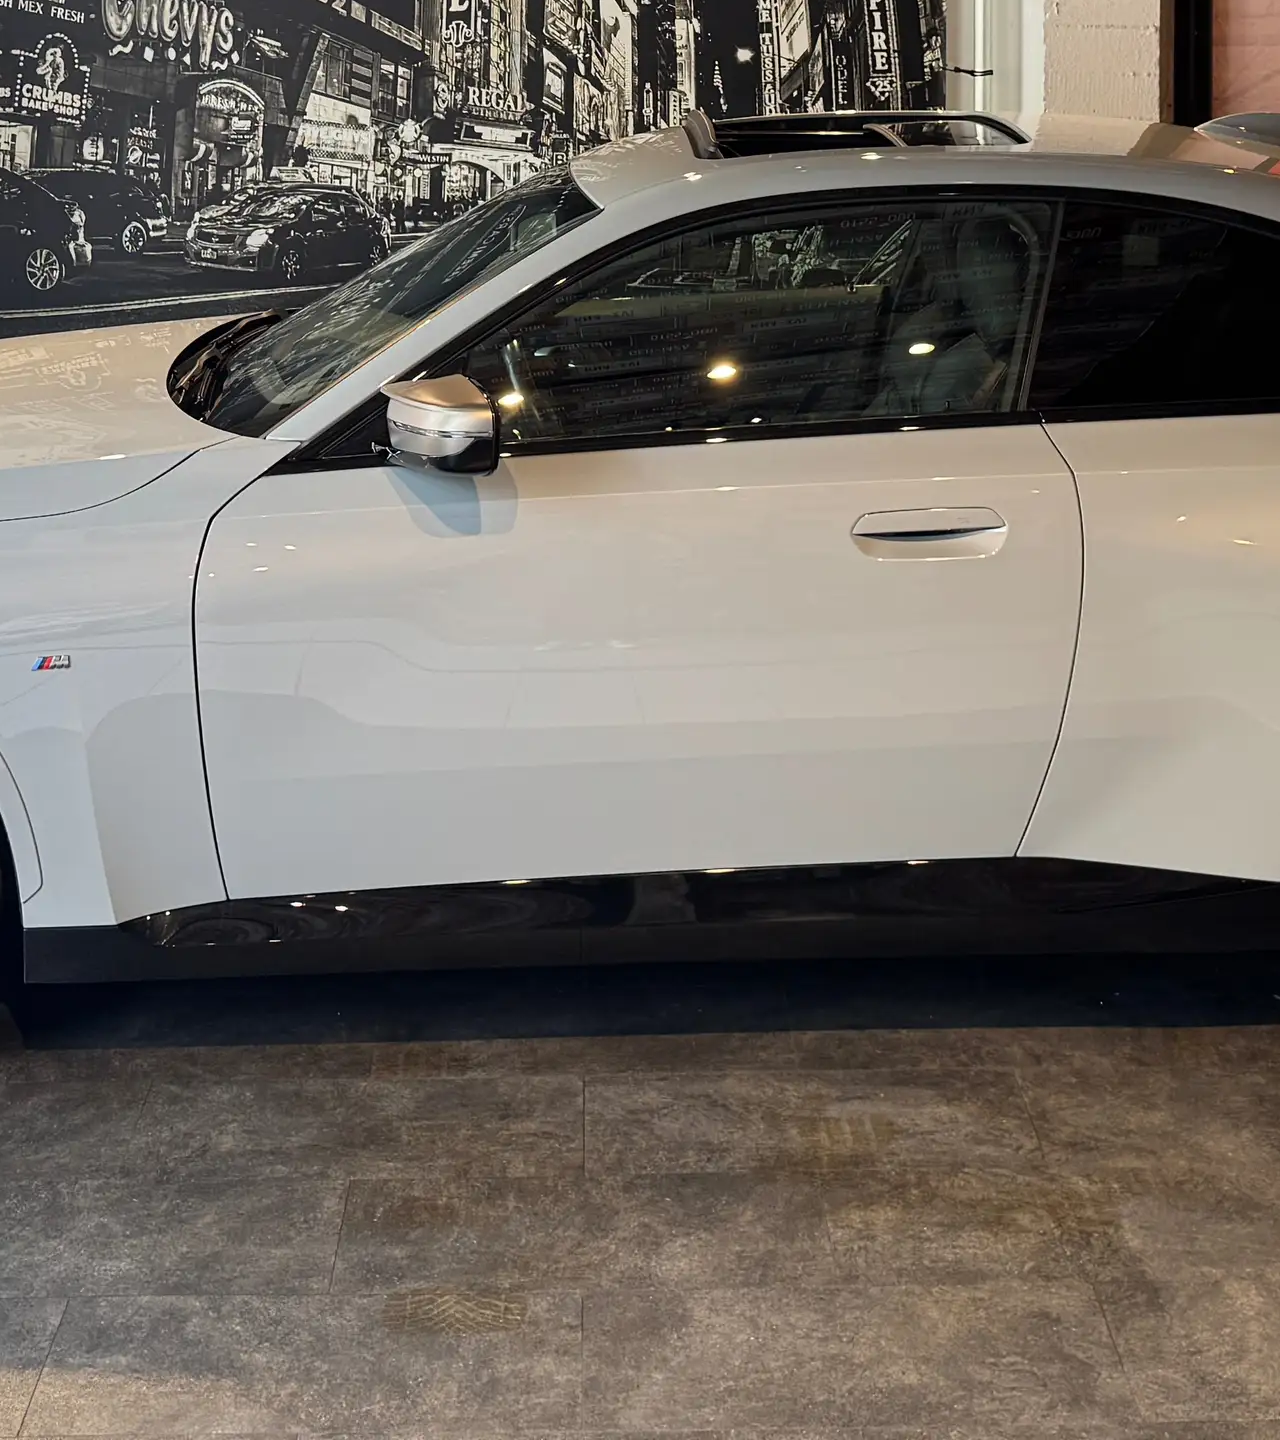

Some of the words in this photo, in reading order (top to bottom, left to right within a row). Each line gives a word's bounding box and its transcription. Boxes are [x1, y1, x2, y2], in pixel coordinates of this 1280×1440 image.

[51, 6, 85, 24] FRESH
[22, 84, 81, 105] CRUMBS
[469, 87, 526, 111] REGAL
